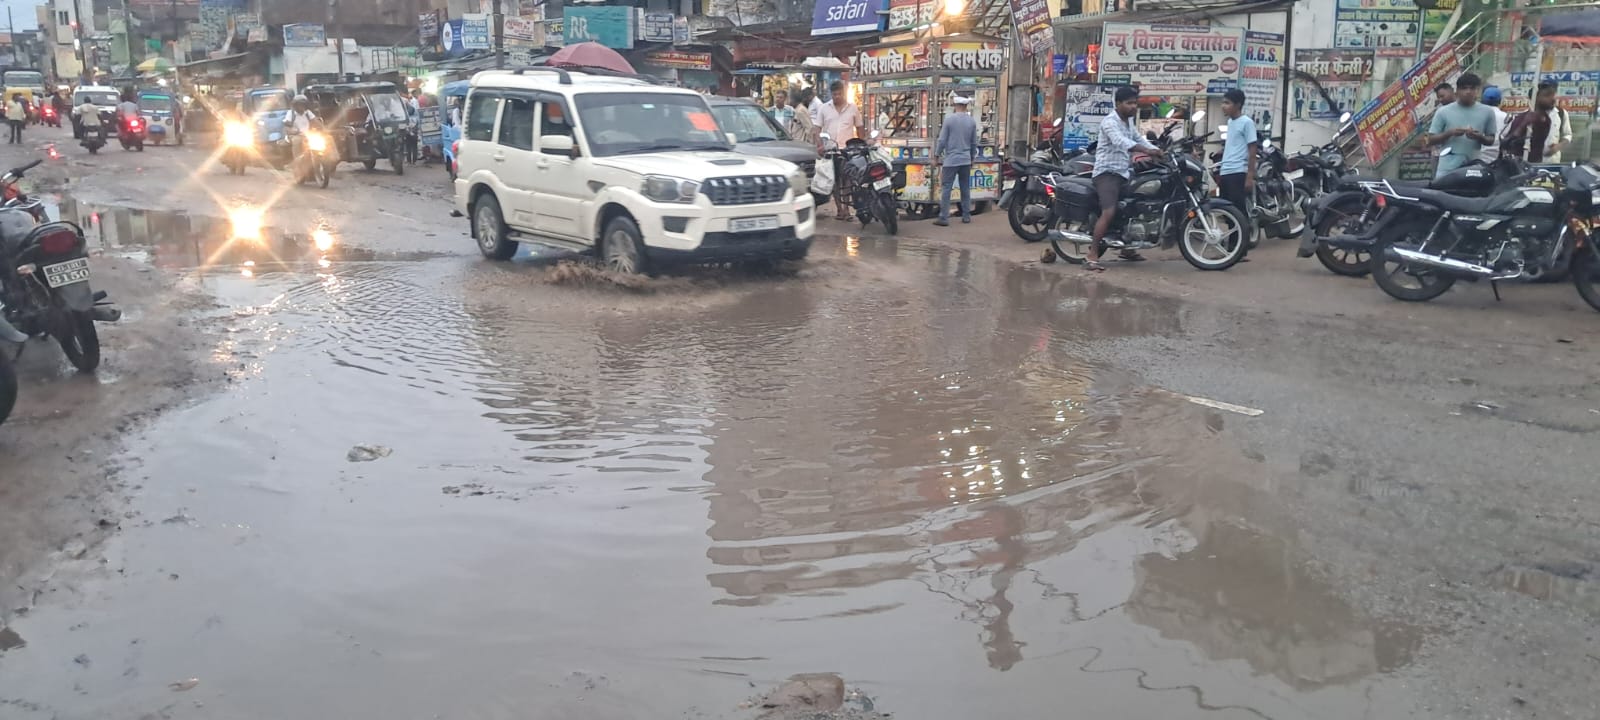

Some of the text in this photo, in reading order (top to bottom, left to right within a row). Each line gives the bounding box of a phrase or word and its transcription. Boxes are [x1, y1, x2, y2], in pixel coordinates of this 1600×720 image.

[826, 1, 868, 21] safari
[570, 16, 591, 39] RR
[1107, 29, 1239, 56] न्यू विजन क्लासेज
[1245, 46, 1278, 62] R.G.S.
[860, 51, 878, 75] शिव
[878, 49, 904, 73] शक्ति
[942, 49, 976, 69] बदाम
[976, 43, 1004, 69] शेक
[1366, 59, 1374, 75] 2
